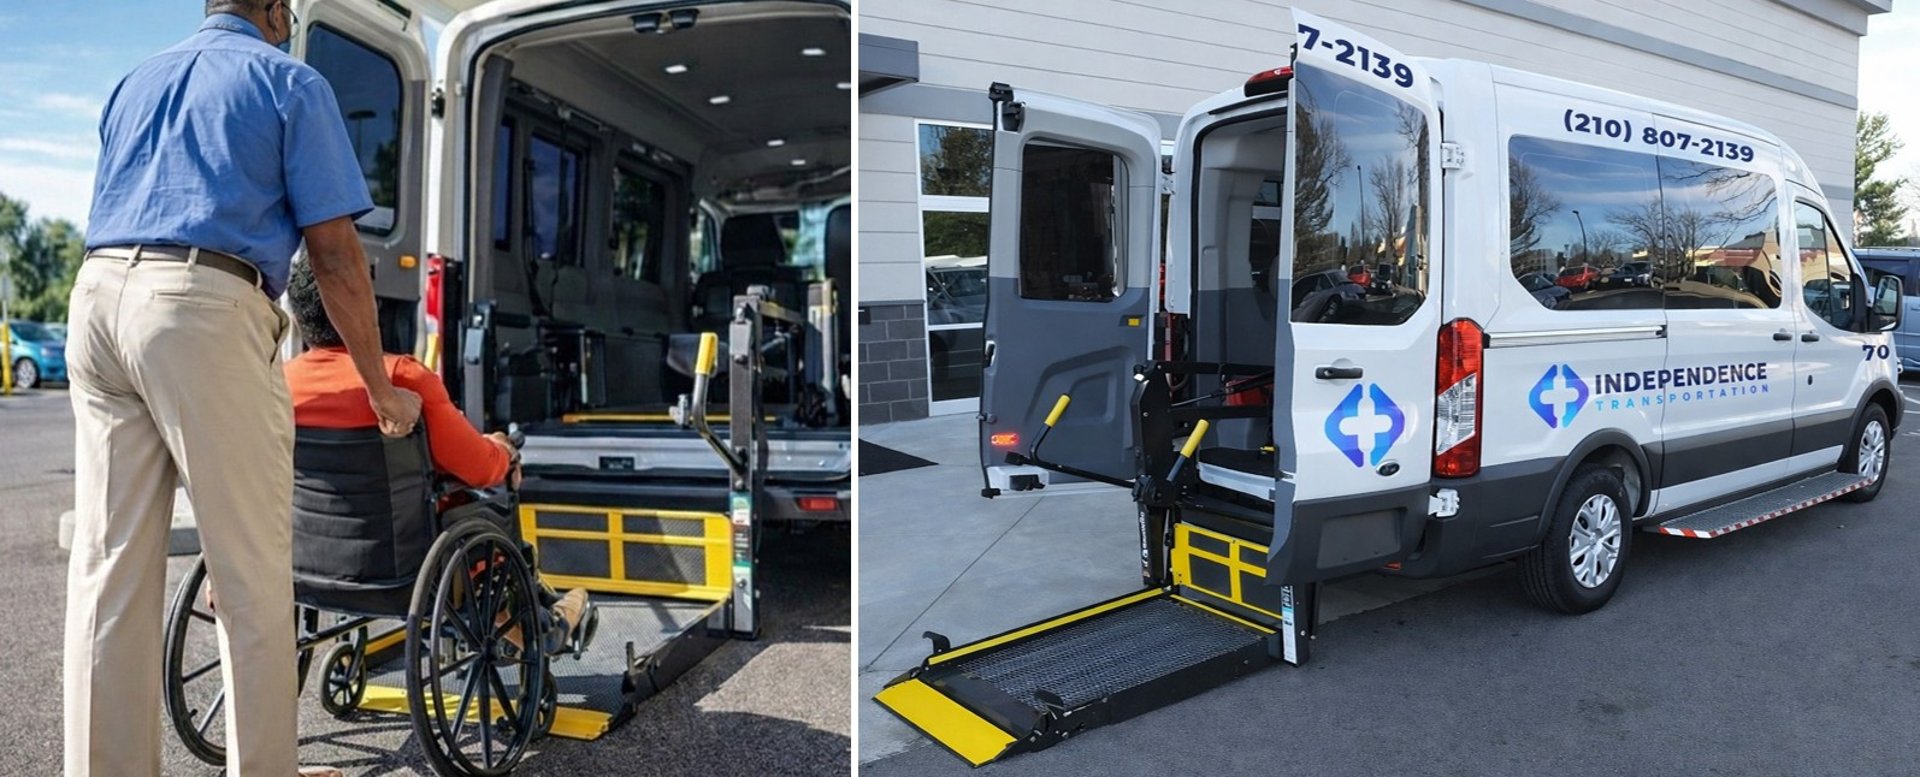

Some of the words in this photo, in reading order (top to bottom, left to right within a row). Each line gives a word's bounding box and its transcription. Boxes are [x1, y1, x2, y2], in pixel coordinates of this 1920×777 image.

[1297, 23, 1414, 88] 7-2139
[1563, 109, 1632, 142] (210)
[1642, 126, 1755, 163] 807-2139
[1862, 344, 1890, 361] 70
[1595, 362, 1767, 395] INDEPENDENCE
[1595, 384, 1769, 411] TRANSPORTATION
